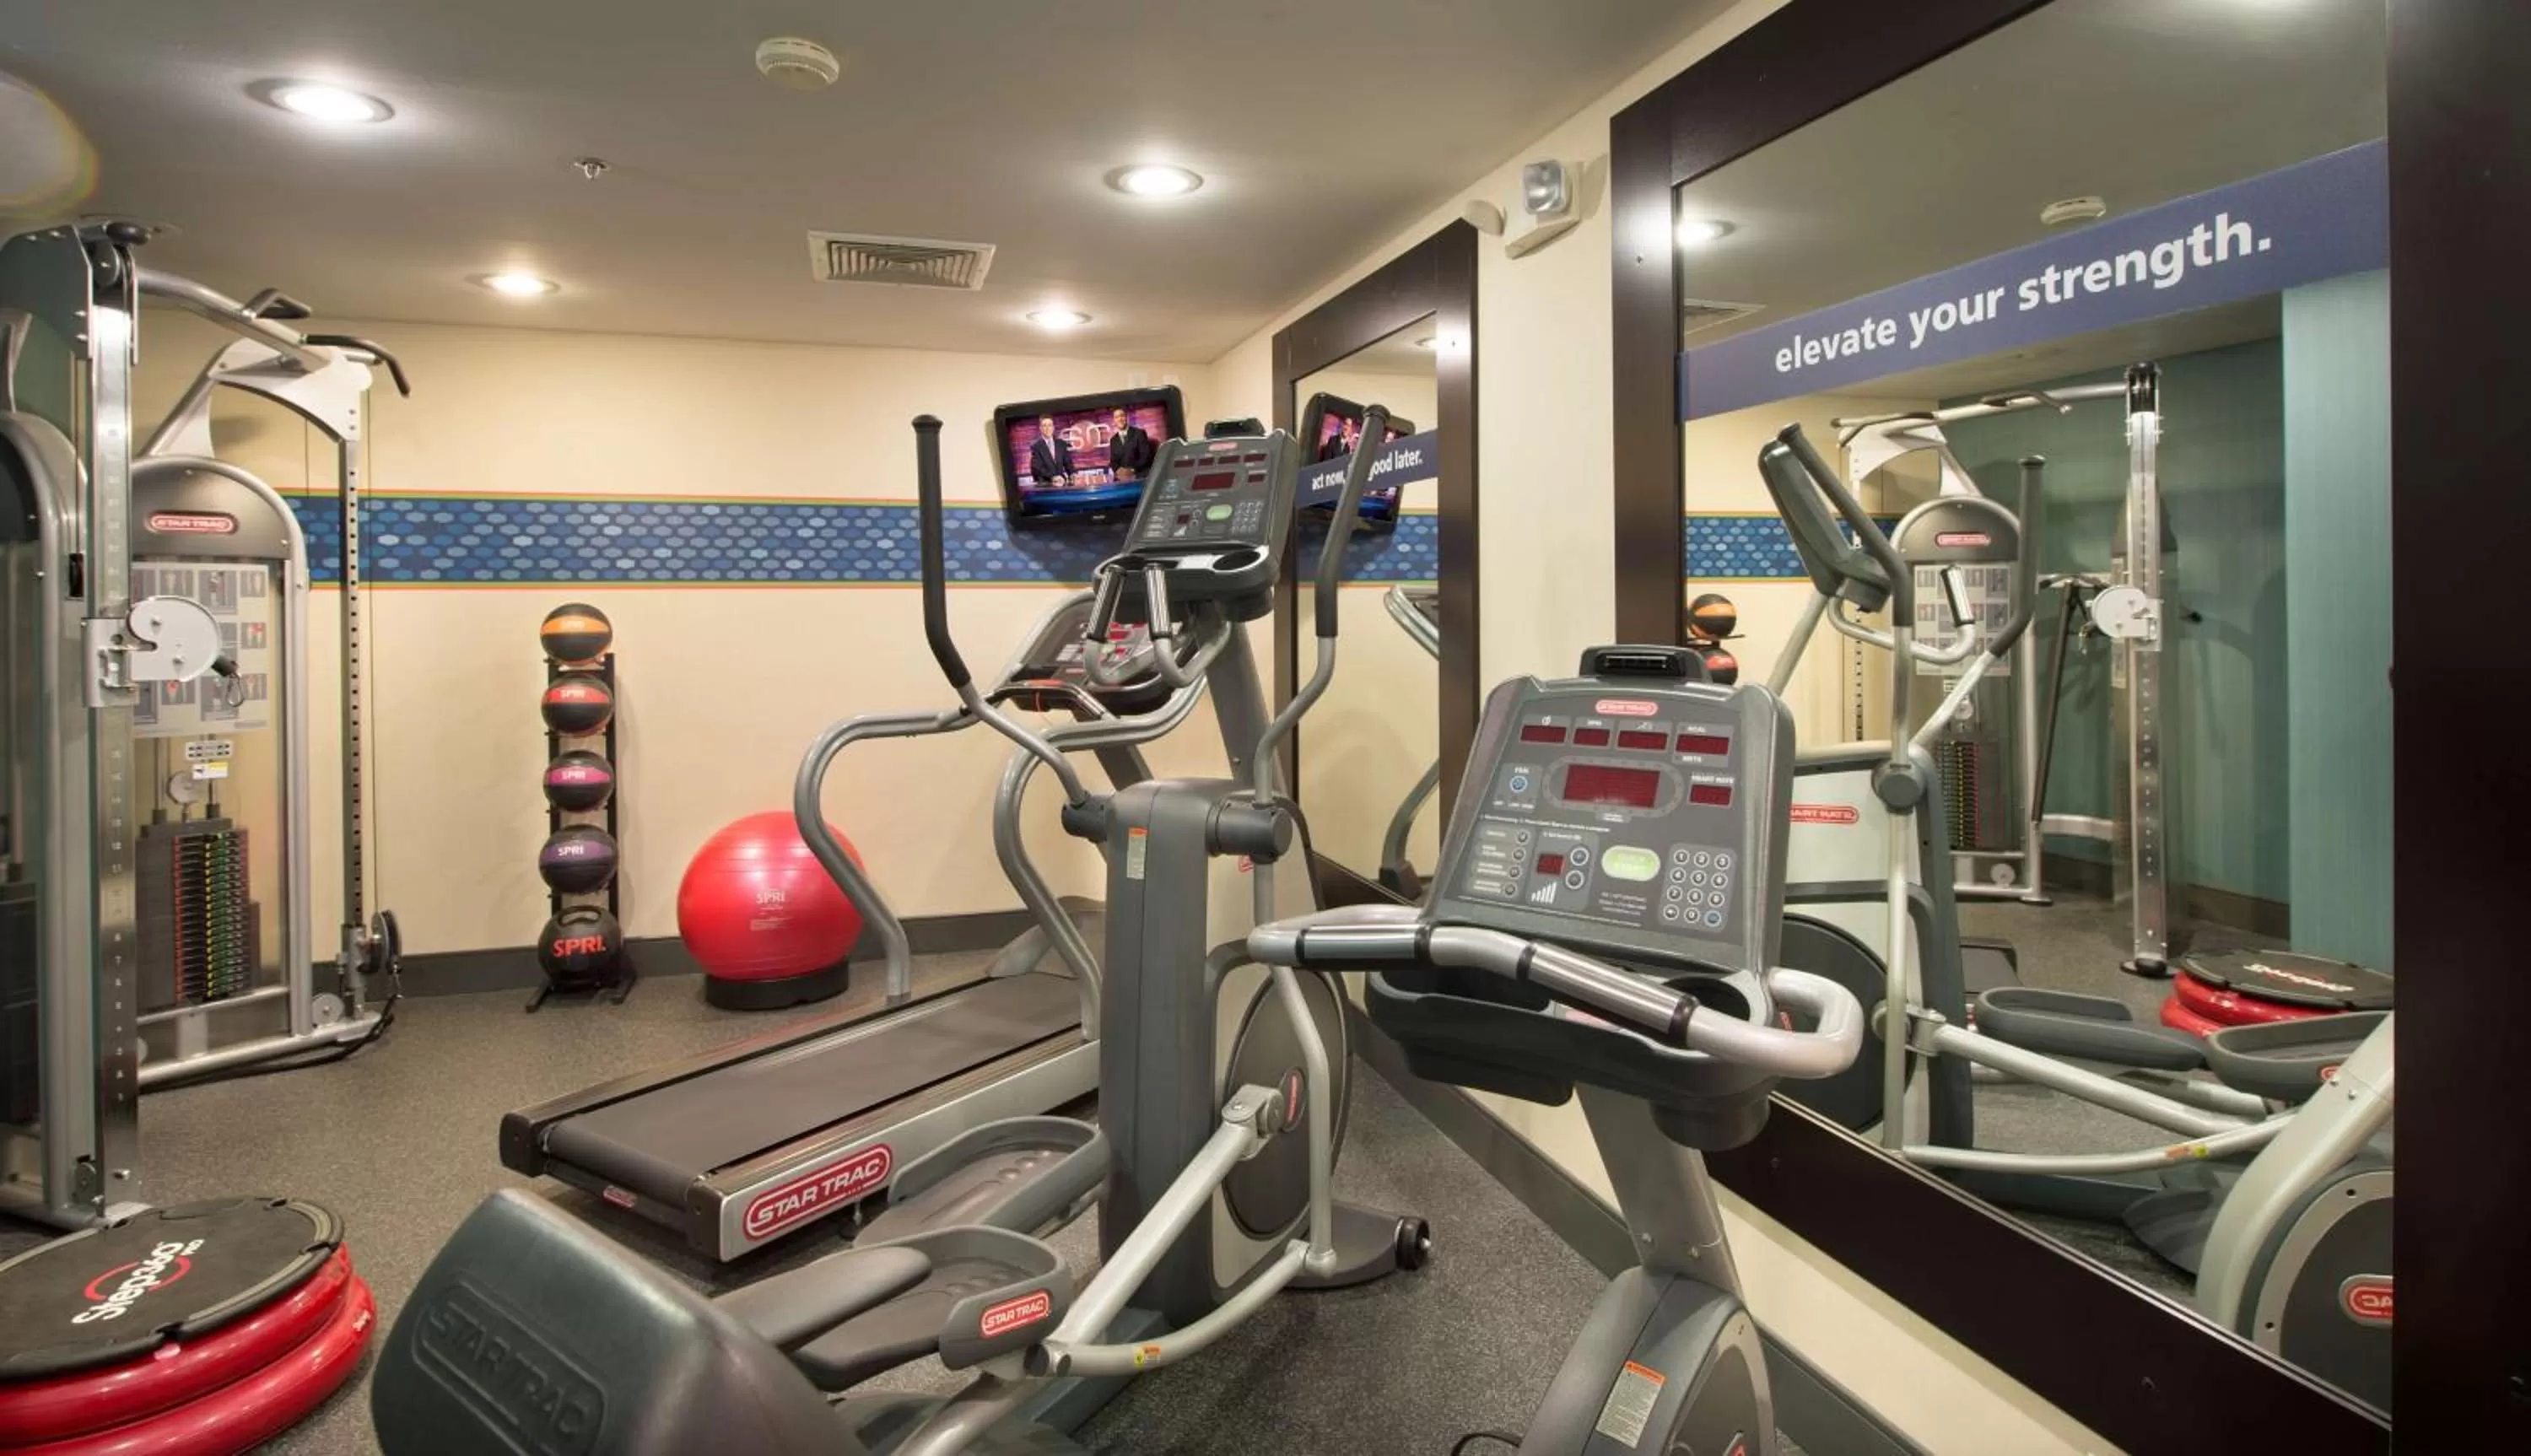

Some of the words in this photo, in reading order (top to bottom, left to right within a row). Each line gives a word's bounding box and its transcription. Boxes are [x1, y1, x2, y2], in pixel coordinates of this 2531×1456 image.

[1775, 317, 1897, 372] elevate
[1908, 288, 2005, 349] your
[2018, 213, 2271, 311] strength.
[1312, 473, 1323, 491] act
[1325, 471, 1346, 488] now,
[1395, 449, 1423, 470] later.
[558, 844, 585, 856] SPRI
[758, 1184, 819, 1221] STAR
[821, 1157, 881, 1196] TRAC
[986, 1308, 1016, 1328] STAR
[1016, 1299, 1044, 1318] TRAC
